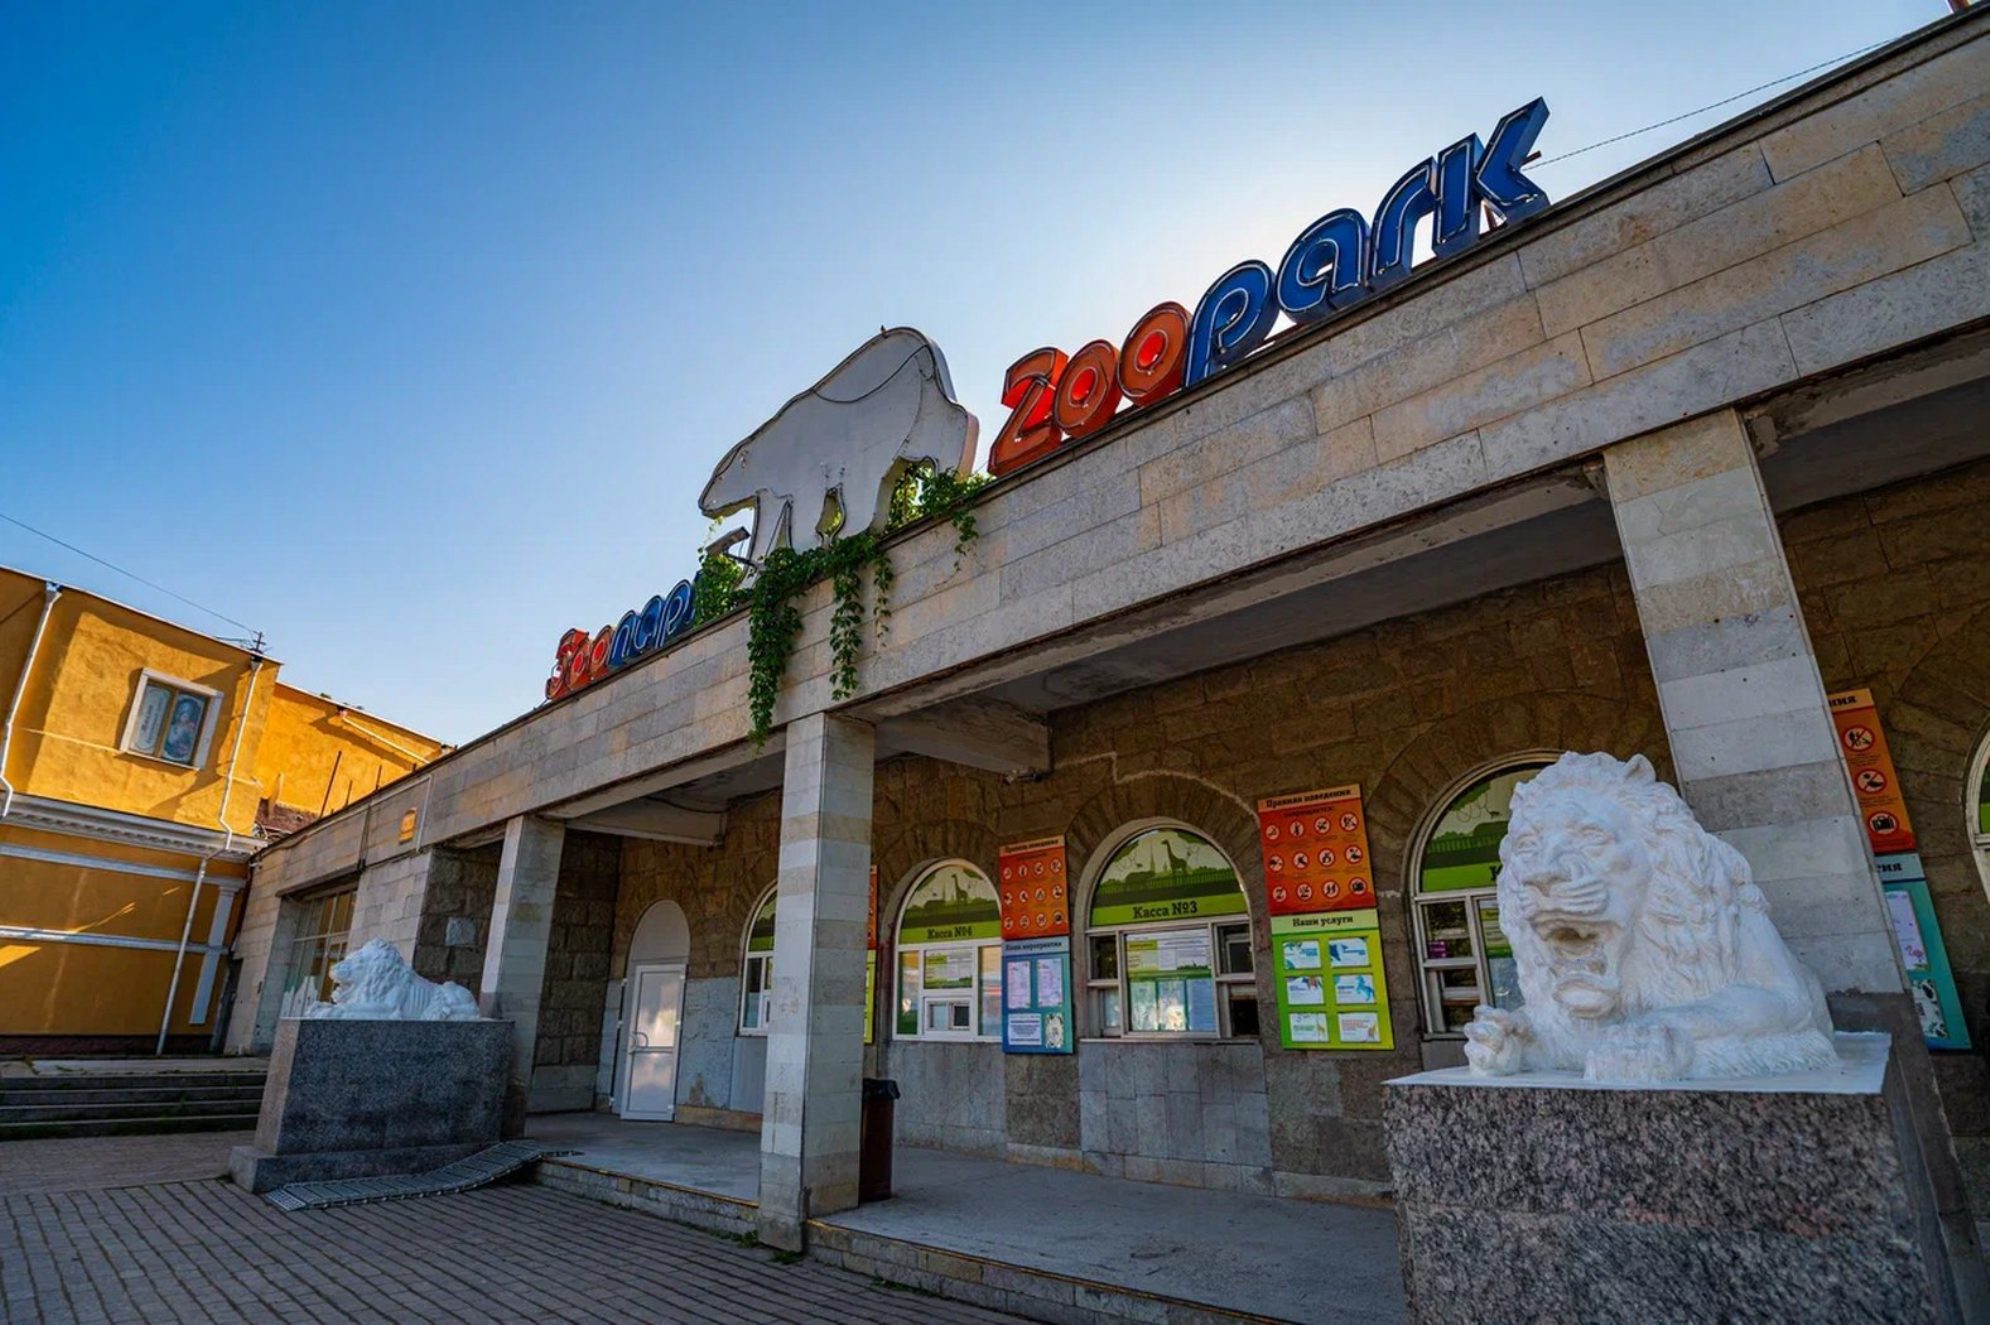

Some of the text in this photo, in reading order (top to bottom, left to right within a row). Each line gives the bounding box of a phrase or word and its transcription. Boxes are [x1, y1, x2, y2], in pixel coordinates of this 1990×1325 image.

[1266, 797, 1303, 809] Правила
[1132, 902, 1198, 920] Касса №3
[1292, 915, 1354, 928] Наши услуги
[927, 927, 952, 940] Касса
